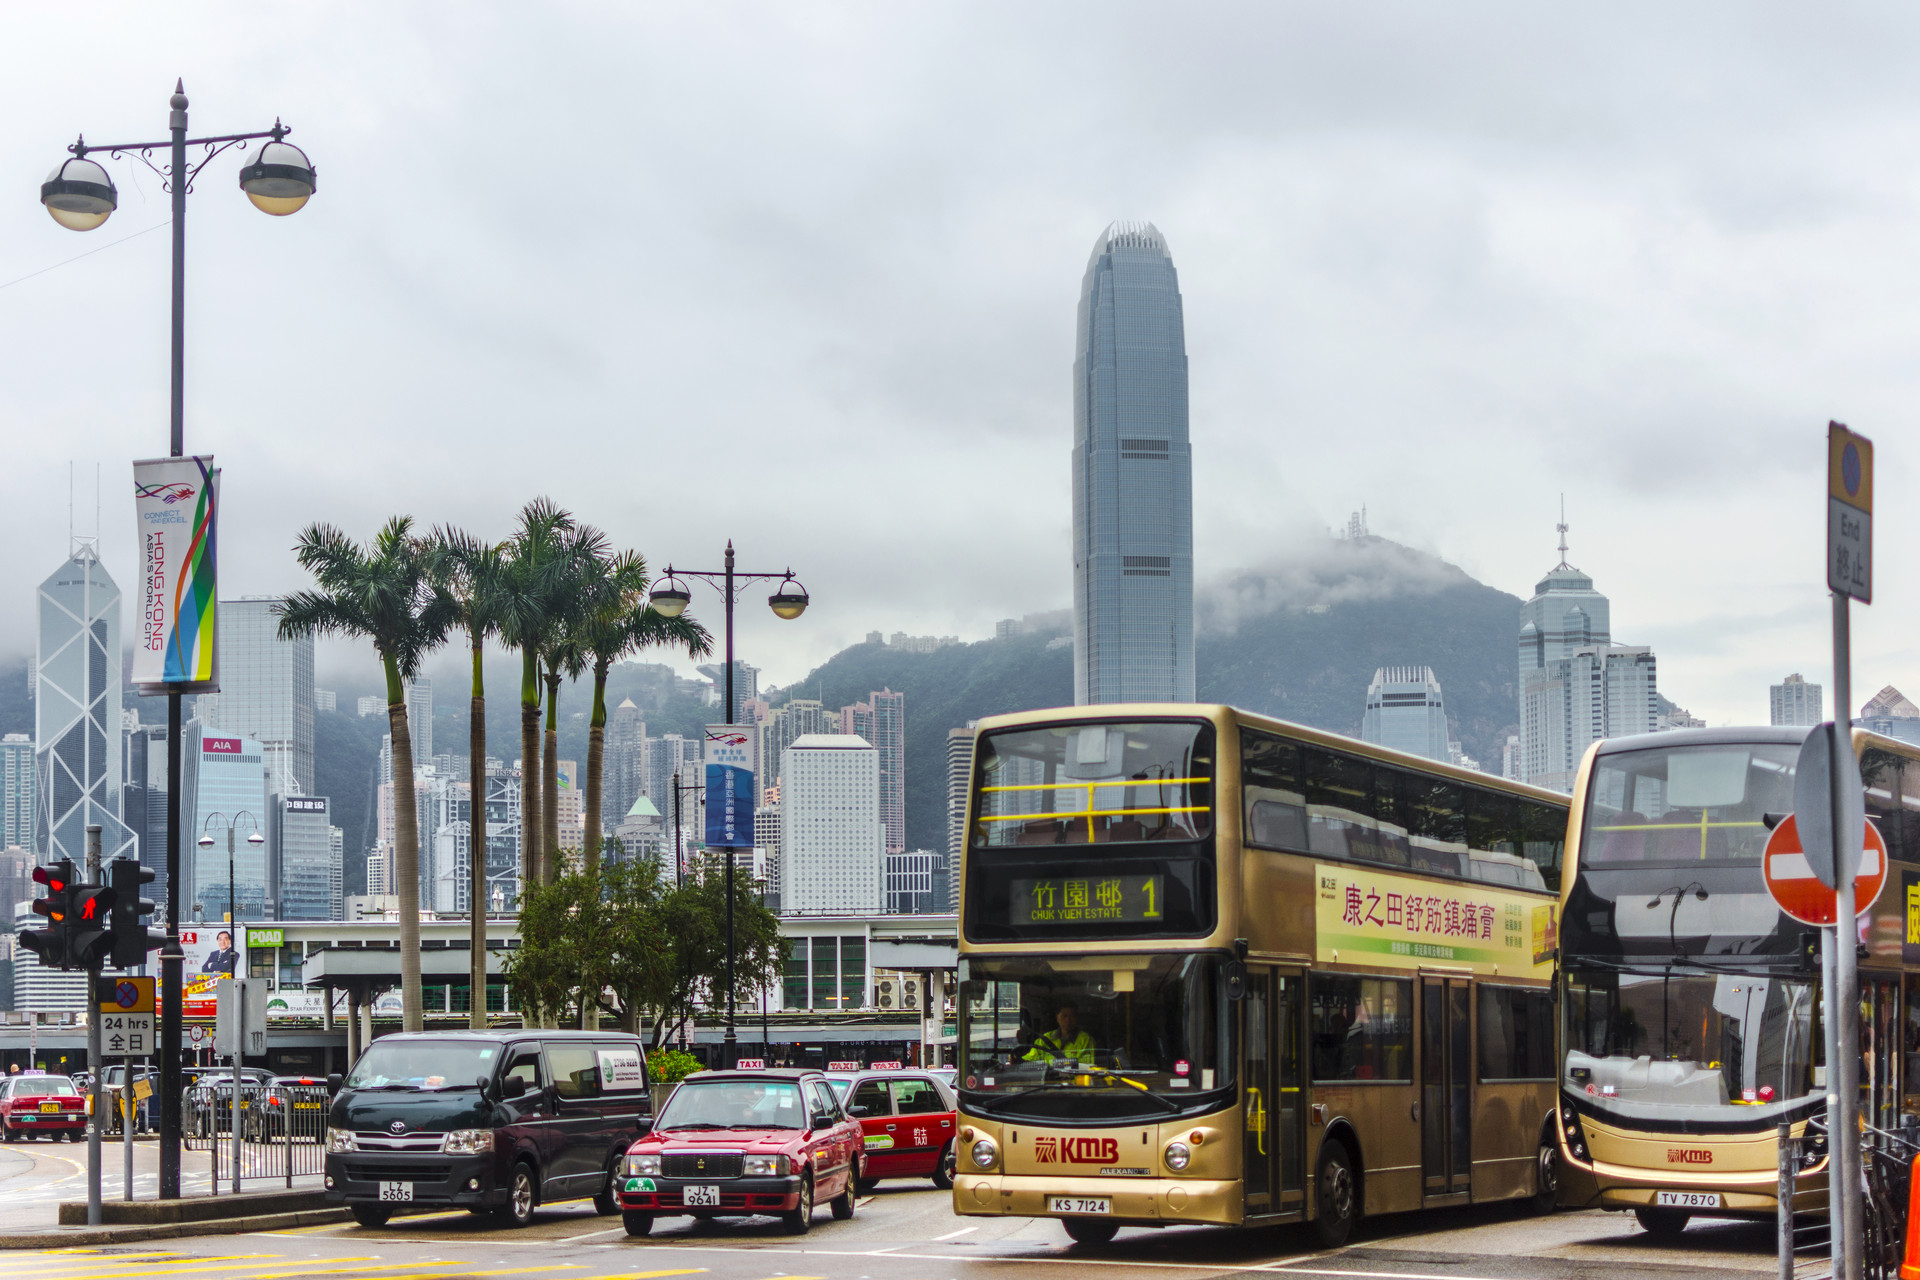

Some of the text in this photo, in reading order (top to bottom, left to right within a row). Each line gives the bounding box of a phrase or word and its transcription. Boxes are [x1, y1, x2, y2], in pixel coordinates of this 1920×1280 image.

[144, 510, 180, 520] CONNECT
[1841, 512, 1860, 542] End
[1836, 544, 1865, 587] 終止
[143, 533, 154, 651] ASIA'S WORLD CITY
[151, 531, 165, 651] HONG KONG
[212, 741, 232, 750] AIA
[495, 768, 513, 777] HSBC
[725, 769, 735, 840] 香港亞洲國際都會
[1031, 879, 1123, 909] 竹園邨
[1142, 877, 1160, 917] 1
[1031, 907, 1123, 920] CHUK YUEN ESTATE
[1342, 883, 1495, 941] 康之田舒筋鎮痛膏
[250, 931, 282, 943] POAD
[105, 1018, 148, 1029] 24 hrs
[109, 1033, 142, 1051] 全日
[913, 1127, 927, 1136] 的士
[913, 1137, 927, 1146] TAXI
[1060, 1137, 1119, 1164] KMB
[1680, 1149, 1713, 1164] KMB
[390, 1182, 403, 1191] LZ
[694, 1187, 709, 1196] JZ
[383, 1191, 410, 1200] 5605
[689, 1195, 716, 1205] 9641
[1662, 1193, 1715, 1206] TV 7870
[1055, 1199, 1105, 1212] KS 7124
